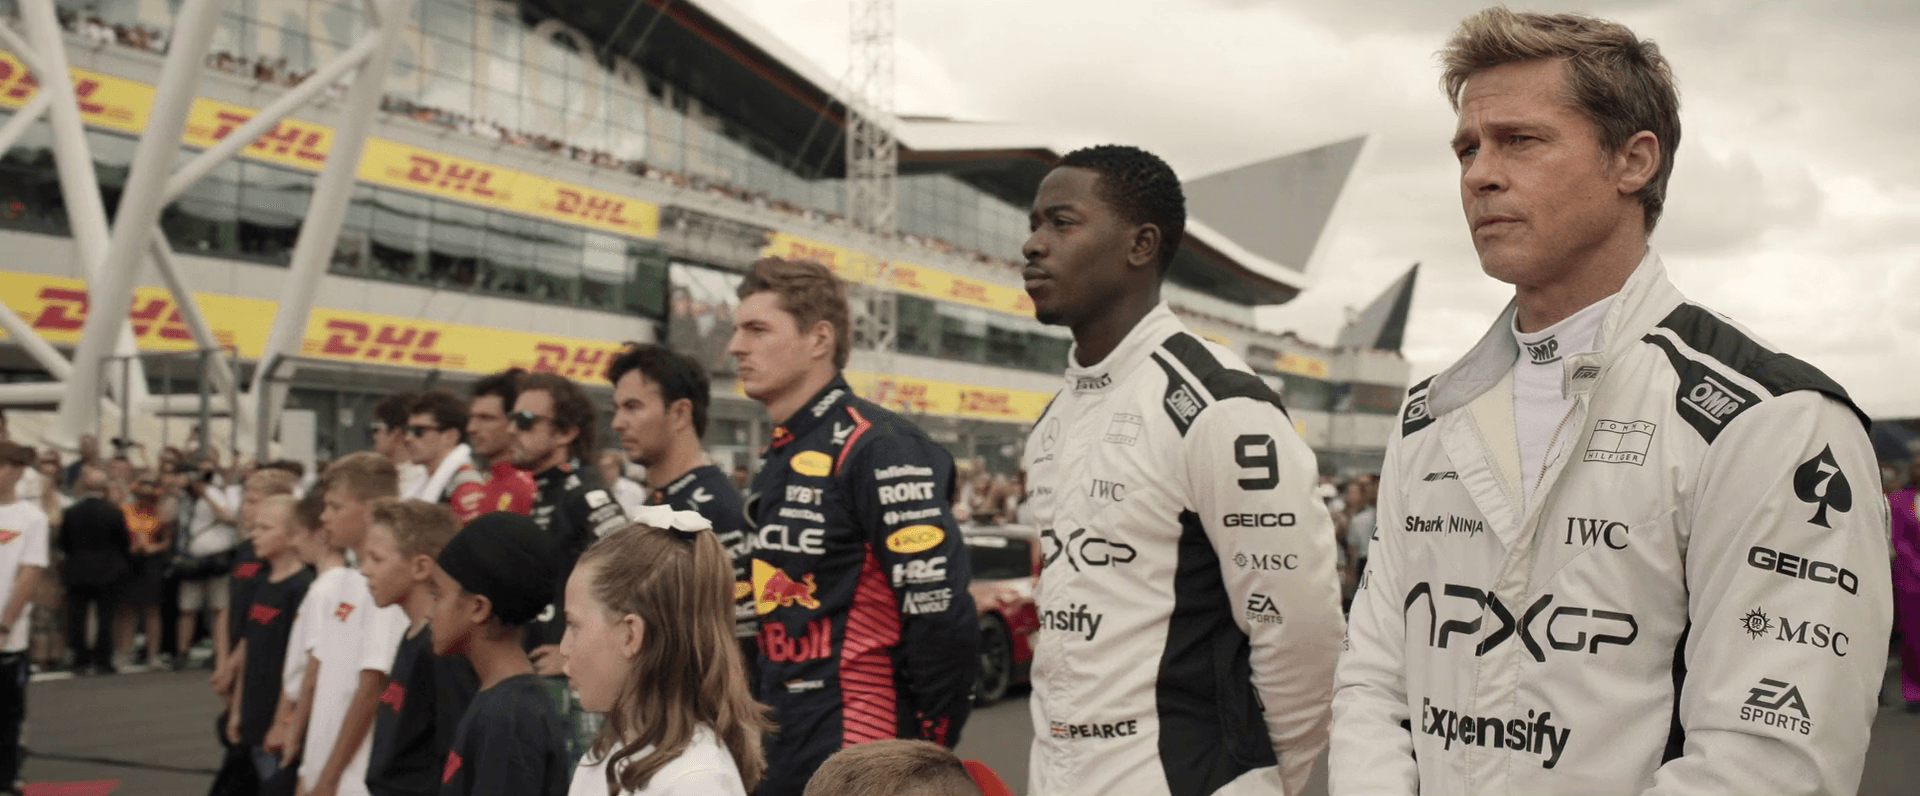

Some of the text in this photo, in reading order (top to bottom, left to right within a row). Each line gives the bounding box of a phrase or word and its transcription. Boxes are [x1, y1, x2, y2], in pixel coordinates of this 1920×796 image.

[404, 154, 495, 197] DHL
[554, 187, 629, 225] DHL
[322, 319, 442, 363] DHL
[1527, 339, 1559, 361] OMP
[1170, 388, 1199, 421] OMP
[1688, 382, 1740, 418] OMP
[1599, 421, 1650, 432] TOMMY
[1234, 434, 1280, 491] 9
[1588, 451, 1639, 463] HILFIGER
[878, 482, 935, 506] ROKT
[1089, 479, 1126, 502] IWC
[1814, 458, 1840, 499] 7
[1223, 513, 1297, 528] GEICO
[1405, 515, 1444, 532] Shark
[1565, 516, 1631, 550] IWC
[1250, 553, 1299, 571] MSC
[1747, 545, 1860, 597] GEICO
[1246, 611, 1284, 625] SPORTS
[1247, 593, 1281, 615] EA
[1040, 602, 1104, 642] nsify
[1775, 616, 1849, 657] MSC
[764, 617, 833, 664] Bull
[1744, 677, 1811, 720] EA
[1069, 719, 1137, 739] PEARCE
[1421, 696, 1571, 770] Expensify
[1739, 706, 1812, 736] SPORTS
